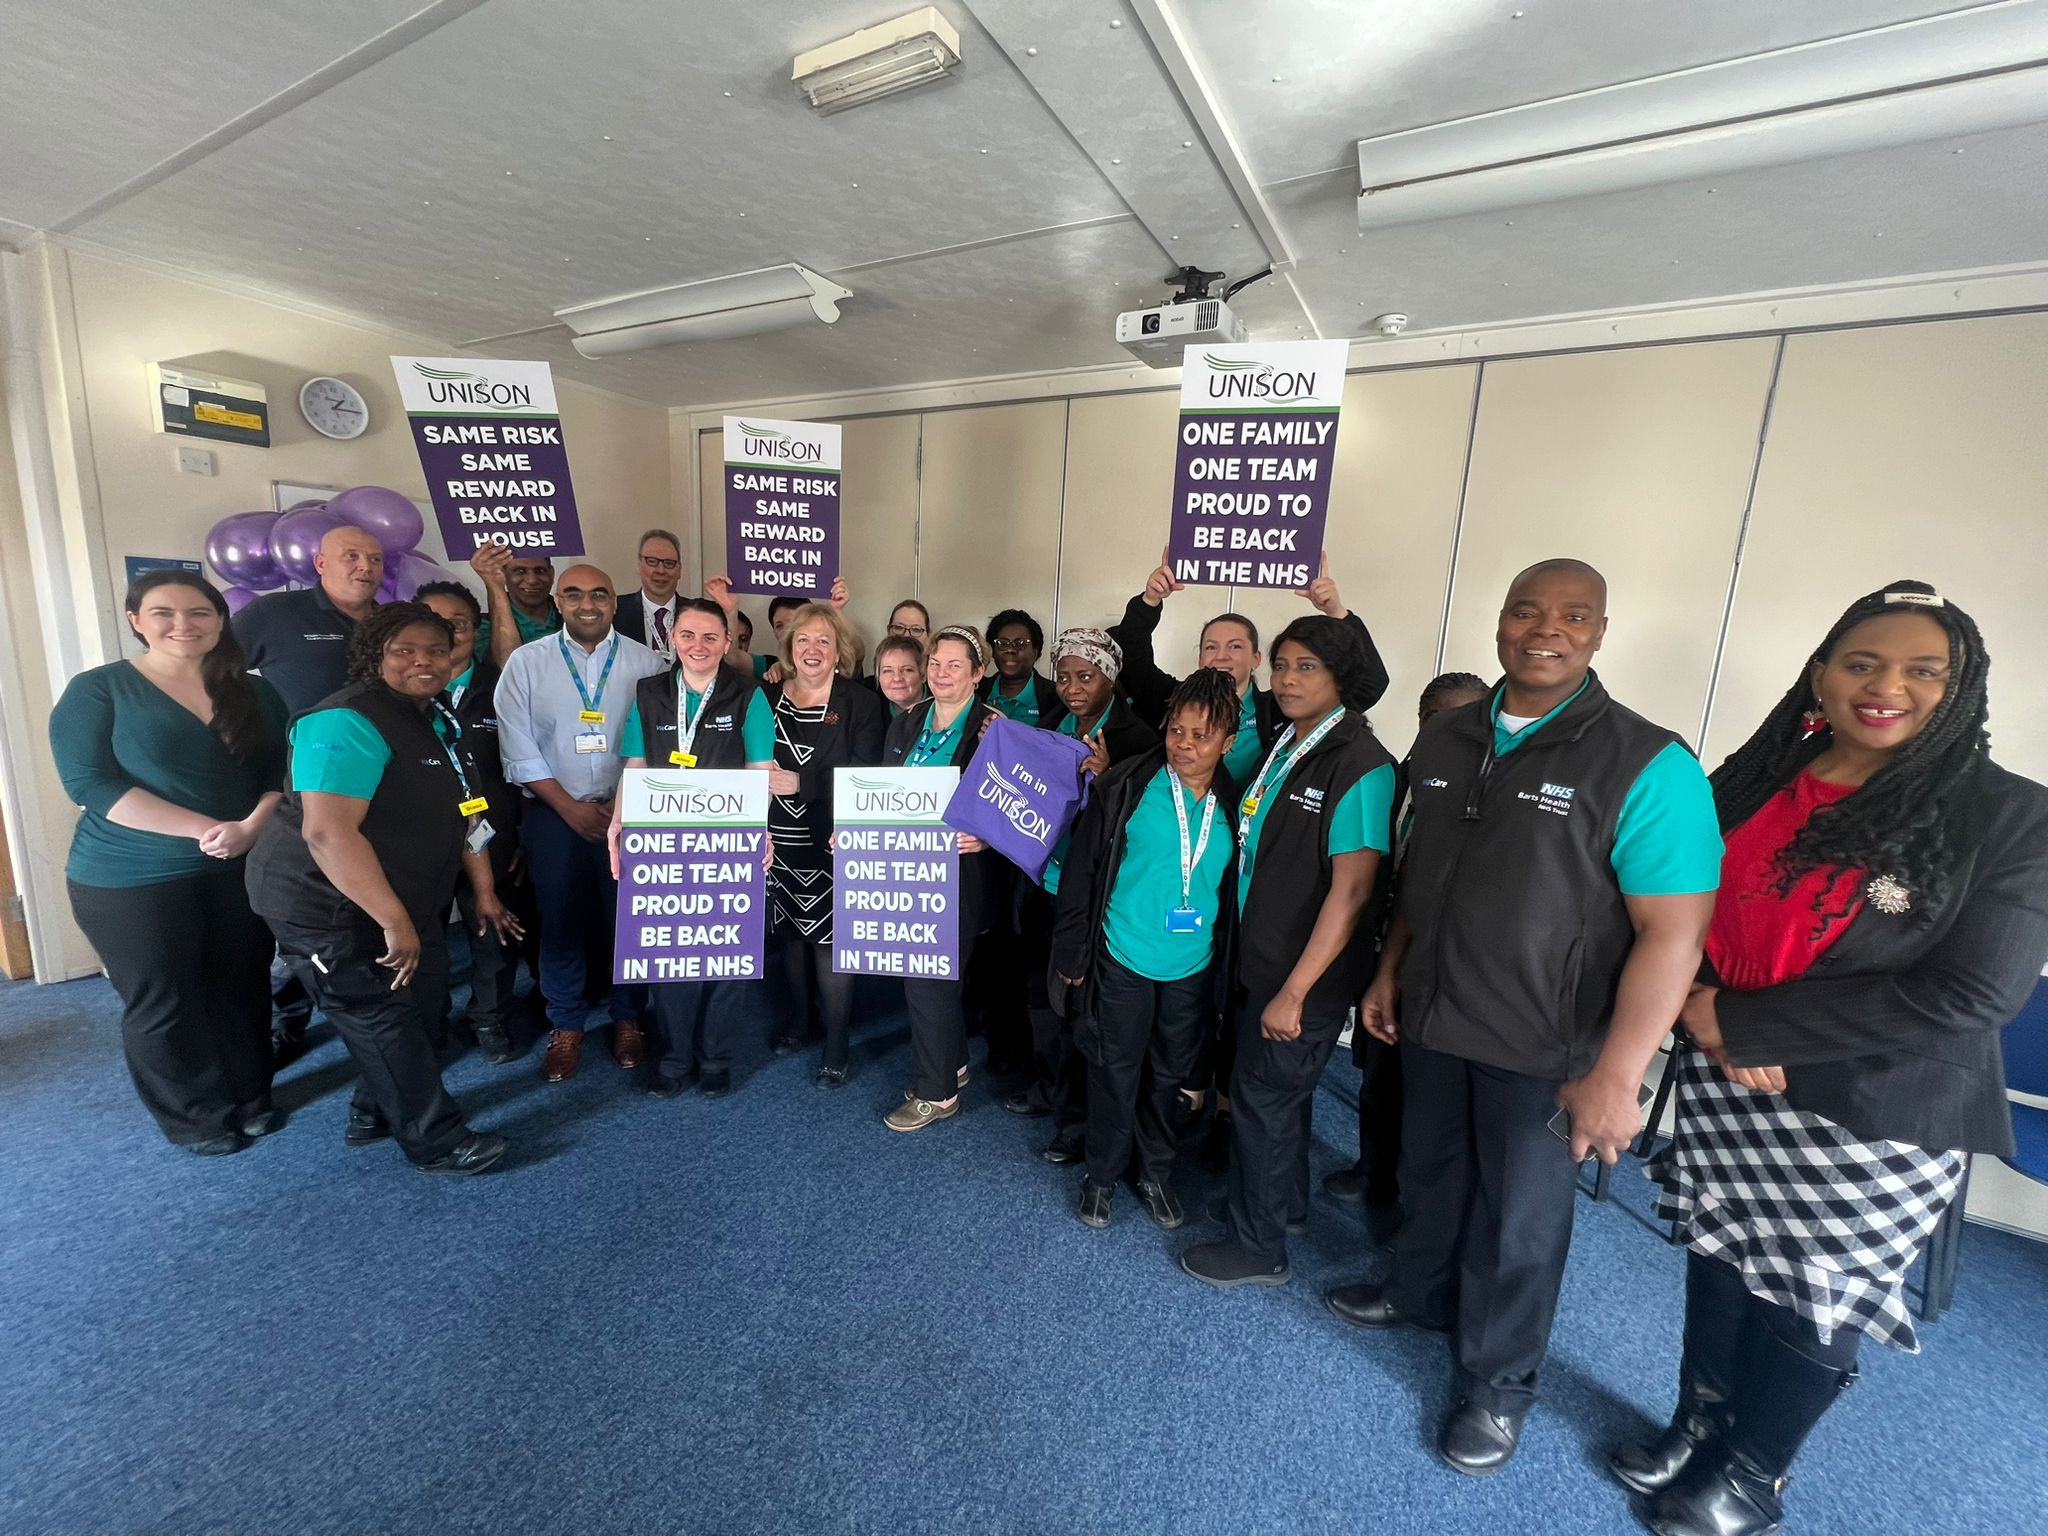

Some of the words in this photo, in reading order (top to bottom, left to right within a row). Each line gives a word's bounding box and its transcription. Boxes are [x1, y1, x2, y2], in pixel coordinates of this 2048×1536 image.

[427, 381, 531, 405] UNISON
[1209, 371, 1316, 398] UNISON
[423, 426, 498, 444] SAME
[502, 427, 560, 445] RISK
[1183, 422, 1235, 446] ONE
[1241, 421, 1333, 445] FAMILY
[744, 438, 822, 461] UNISON
[461, 453, 532, 471] SAME
[1189, 458, 1241, 481] ONE
[1248, 458, 1318, 481] TEAM
[447, 480, 556, 498] REWARD
[733, 473, 788, 493] SAME
[792, 478, 837, 497] RISK
[458, 506, 527, 524] BACK
[531, 506, 557, 522] IN
[756, 499, 810, 518] SAME
[1186, 493, 1271, 516] PROUD
[1278, 494, 1312, 517] TO
[473, 530, 556, 549] HOUSE
[740, 522, 825, 543] REWARD
[1194, 527, 1225, 549] BE
[1230, 528, 1298, 552] BACK
[745, 546, 796, 564] BACK
[802, 550, 822, 566] IN
[751, 570, 816, 588] HOUSE
[1176, 559, 1199, 580] IN
[1206, 561, 1252, 583] THE
[1258, 563, 1309, 586] NHS
[1034, 778, 1048, 796] in
[1304, 787, 1325, 800] NHS
[1540, 783, 1575, 799] NHS
[650, 793, 743, 813] UNISON
[856, 791, 938, 812] UNISON
[978, 779, 1052, 840] UNISON
[1540, 796, 1571, 810] Health
[625, 833, 676, 854] ONE
[681, 833, 762, 853] FAMILY
[837, 831, 879, 850] ONE
[884, 831, 955, 852] FAMILY
[633, 864, 683, 885] ONE
[689, 863, 752, 884] TEAM
[845, 860, 886, 881] ONE
[891, 861, 946, 882] TEAM
[632, 895, 714, 916] PROUD
[719, 894, 751, 914] TO
[845, 890, 913, 912] PROUD
[918, 893, 946, 914] TO
[640, 926, 671, 947] BE
[678, 924, 741, 946] BACK
[853, 920, 879, 941] BE
[883, 922, 938, 944] BACK
[623, 959, 648, 980] IN
[655, 957, 701, 979] THE
[706, 955, 754, 977] NHS
[840, 950, 860, 970] IN
[865, 951, 904, 973] THE
[909, 953, 951, 976] NHS
